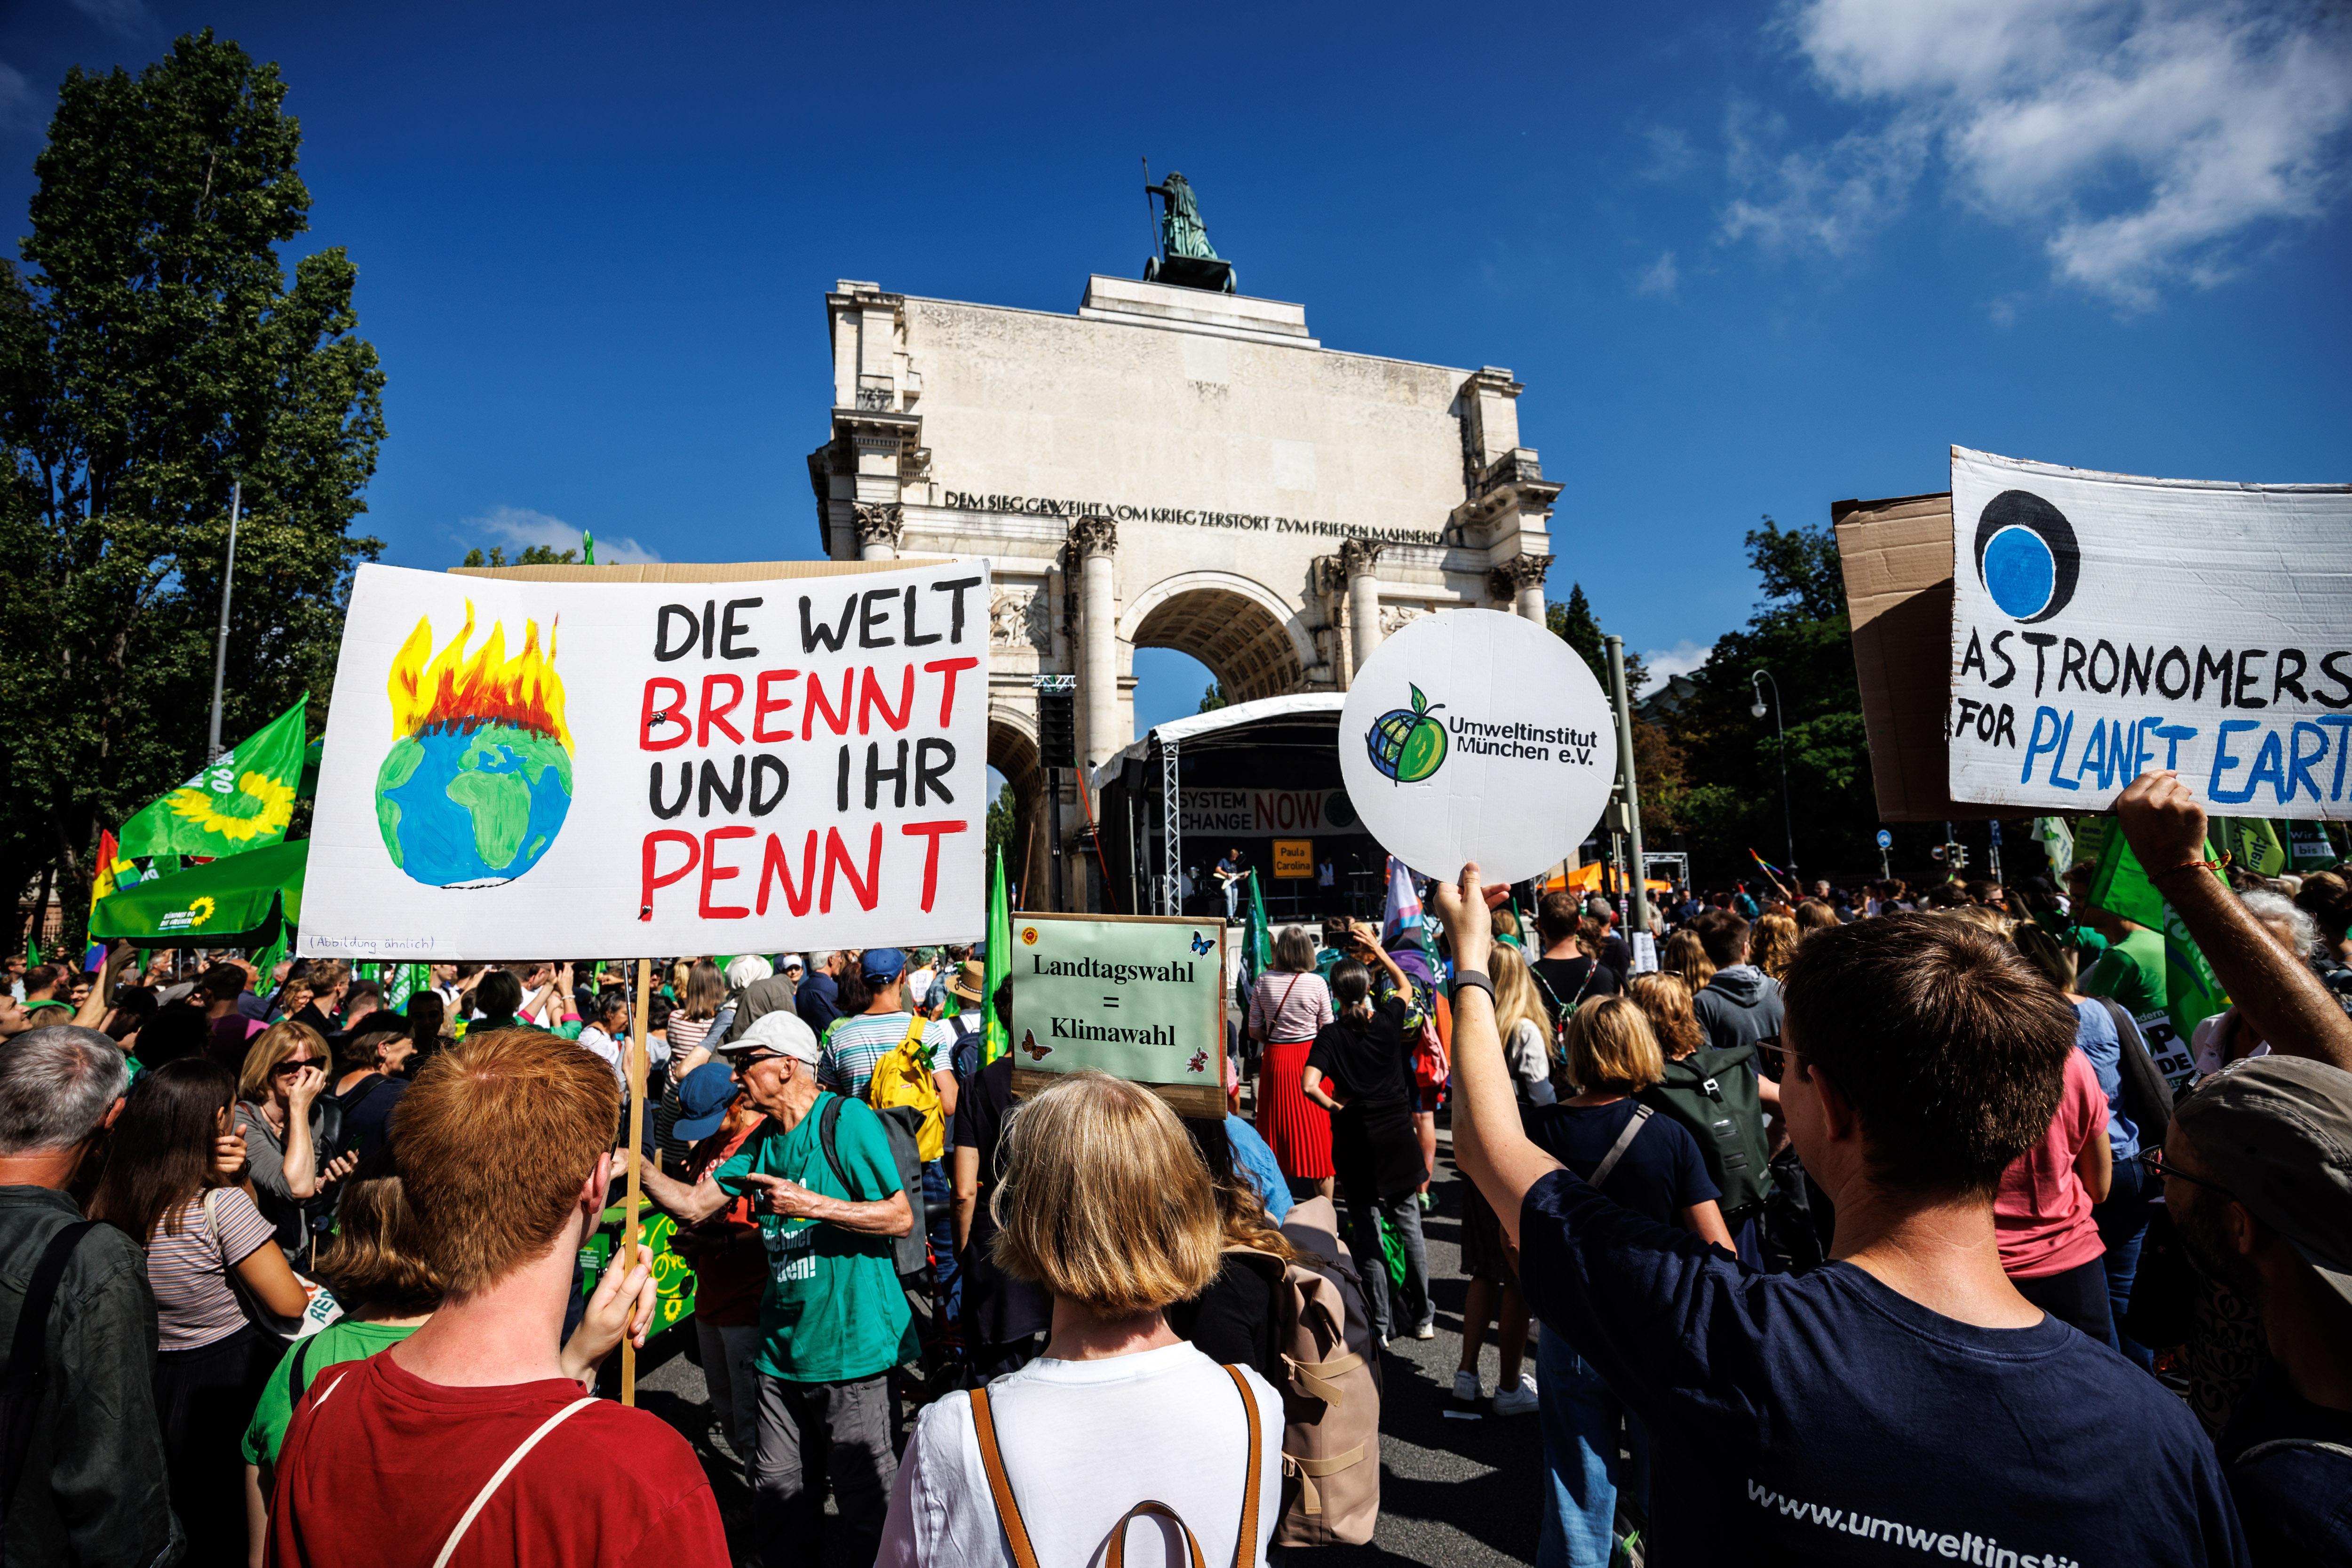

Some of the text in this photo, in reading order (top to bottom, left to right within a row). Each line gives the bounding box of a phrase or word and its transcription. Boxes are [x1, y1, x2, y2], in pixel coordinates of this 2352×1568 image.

[945, 491, 985, 508] DEM
[988, 494, 1024, 513] SIEG
[1026, 498, 1102, 517] GEWEIHT
[1105, 503, 1147, 522] VOM
[1151, 507, 1196, 526] KRIEG
[1274, 517, 1311, 534] ZVM
[1312, 521, 1369, 538] FRIEDEN
[1372, 526, 1444, 544] MAHNEND
[653, 576, 983, 661] DIE WELT
[1961, 625, 2352, 709] ASTRONOMERS
[640, 656, 980, 751] BRENNT
[1449, 716, 1598, 748] Umweltinstitut
[1457, 736, 1594, 766] München e.V.
[1955, 697, 2352, 805] FOR PLANET EART
[649, 737, 957, 820] UND IHR
[1179, 791, 1247, 809] SYSTEM
[1254, 792, 1321, 830] NOW
[1179, 813, 1252, 830] CHANGE
[1276, 861, 1311, 870] Carolina
[1280, 847, 1305, 856] Paula
[2299, 845, 2319, 855] bis
[641, 820, 969, 923] PENNT
[310, 935, 434, 954] (Abbildung ähnlich)
[1033, 954, 1195, 985] Landtagswahl
[1103, 996, 1119, 1008] =
[1050, 1017, 1176, 1046] Klimawahl
